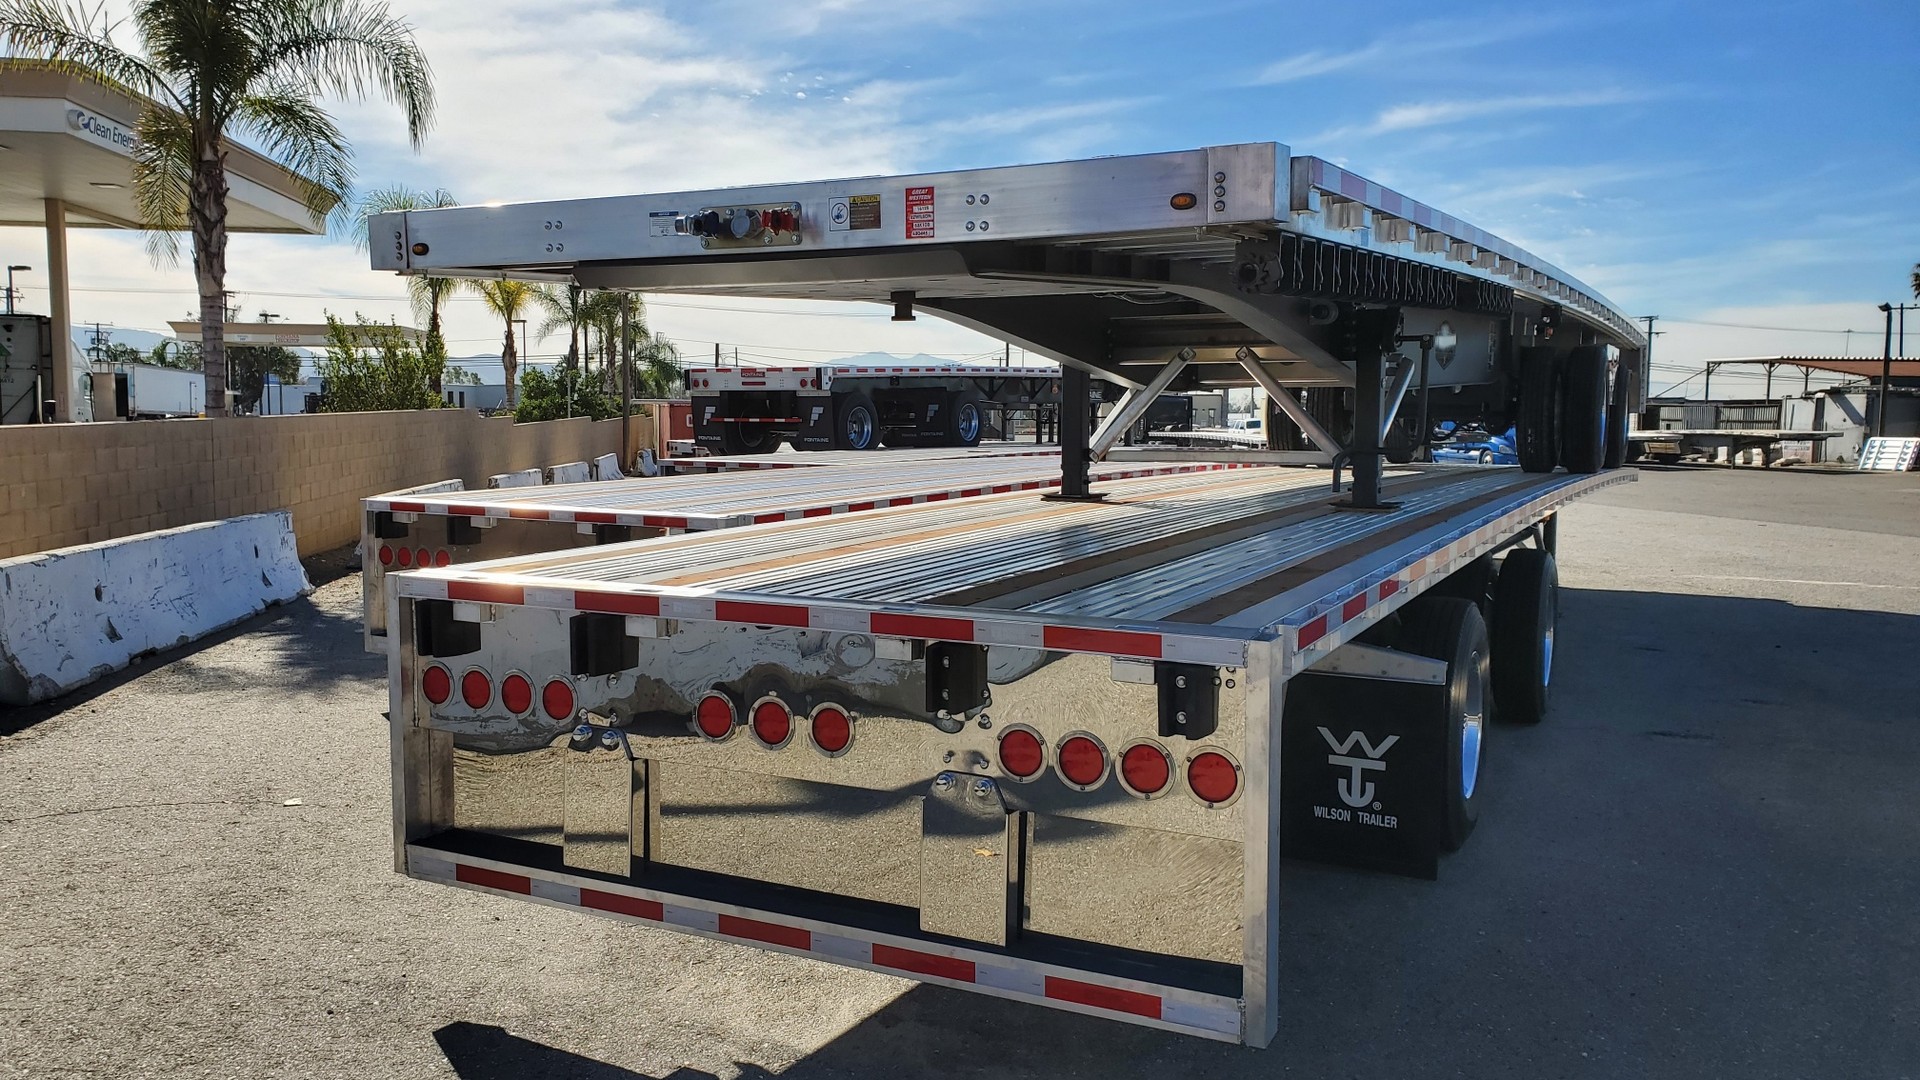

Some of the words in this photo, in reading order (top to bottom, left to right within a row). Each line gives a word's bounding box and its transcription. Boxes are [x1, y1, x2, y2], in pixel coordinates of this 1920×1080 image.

[88, 116, 111, 140] Clean
[1313, 805, 1351, 822] WILSON
[1357, 811, 1398, 829] TRAILER
